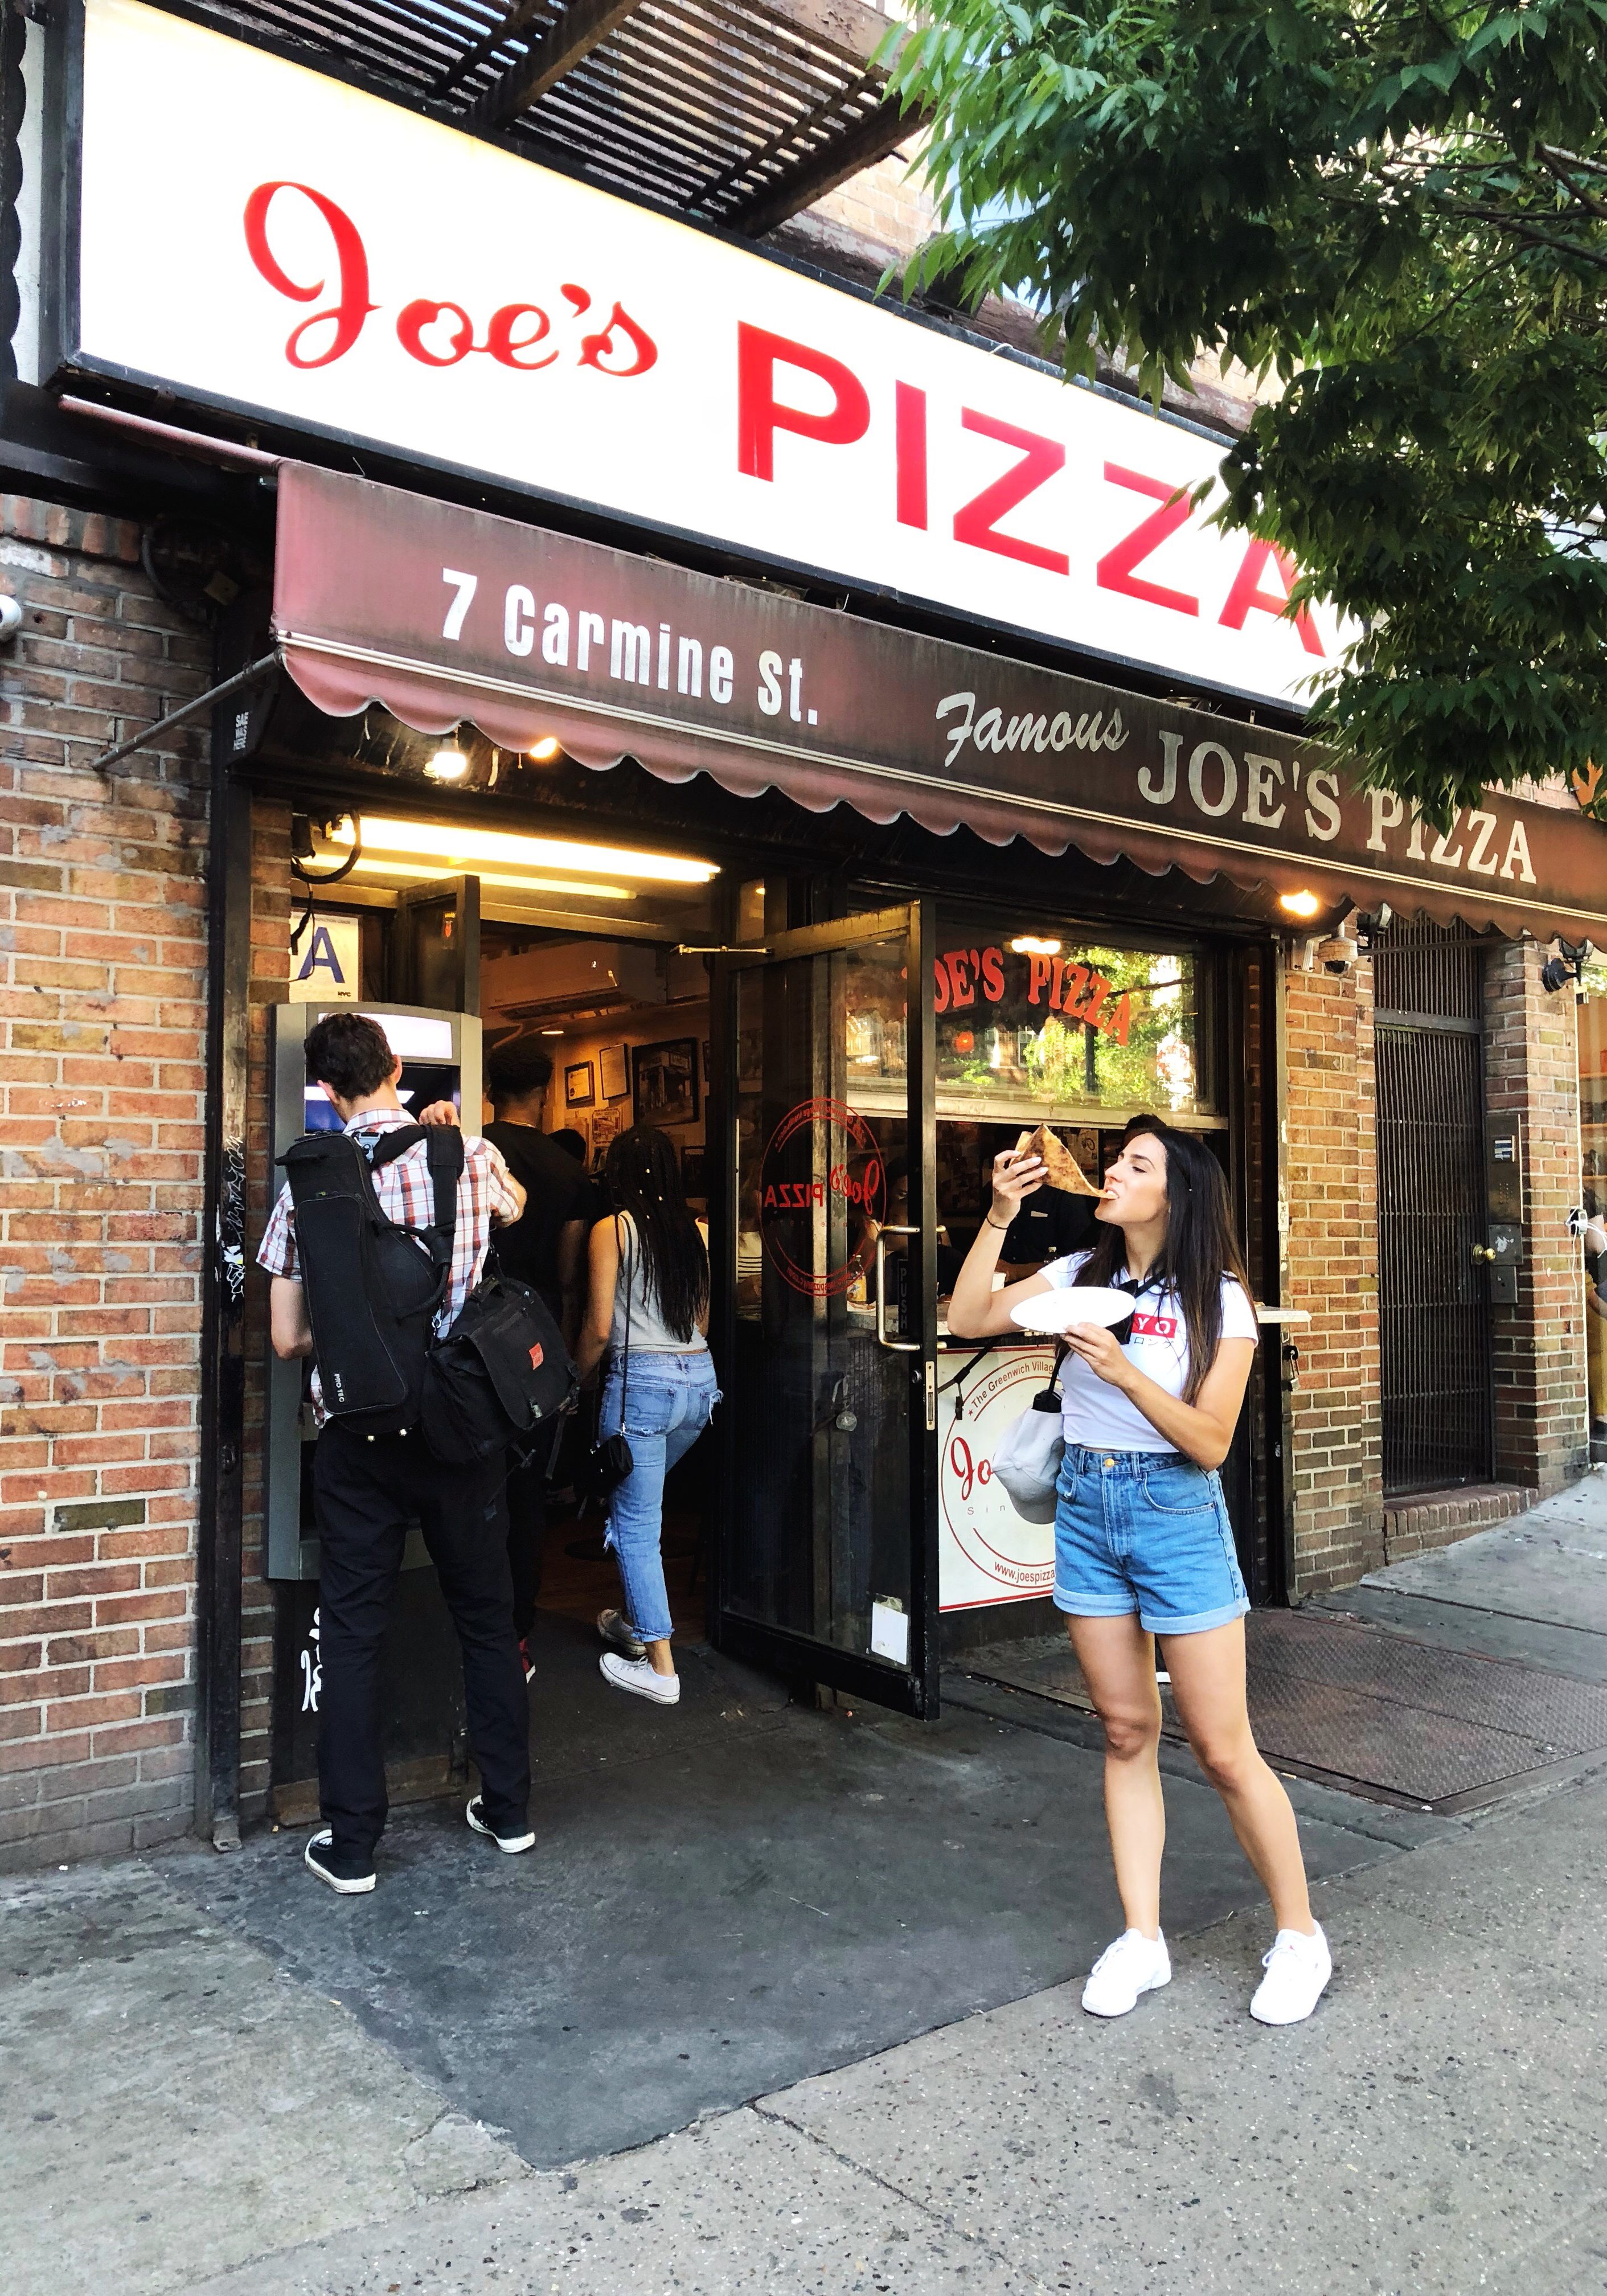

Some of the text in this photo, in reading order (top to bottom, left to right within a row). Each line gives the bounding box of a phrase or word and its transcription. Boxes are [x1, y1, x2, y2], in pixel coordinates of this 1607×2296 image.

[244, 181, 1326, 658] Joe's PIZZA
[442, 567, 818, 725] 7 Carmine St.
[935, 691, 1537, 884] Famous JOE'S PIZZA
[297, 926, 346, 983] A
[901, 946, 1130, 1047] OE'S PIZZA
[971, 1361, 1054, 1409] The Greenwich Villag
[967, 1505, 1006, 1516] Sin
[994, 1561, 1055, 1585] www.joespizza
